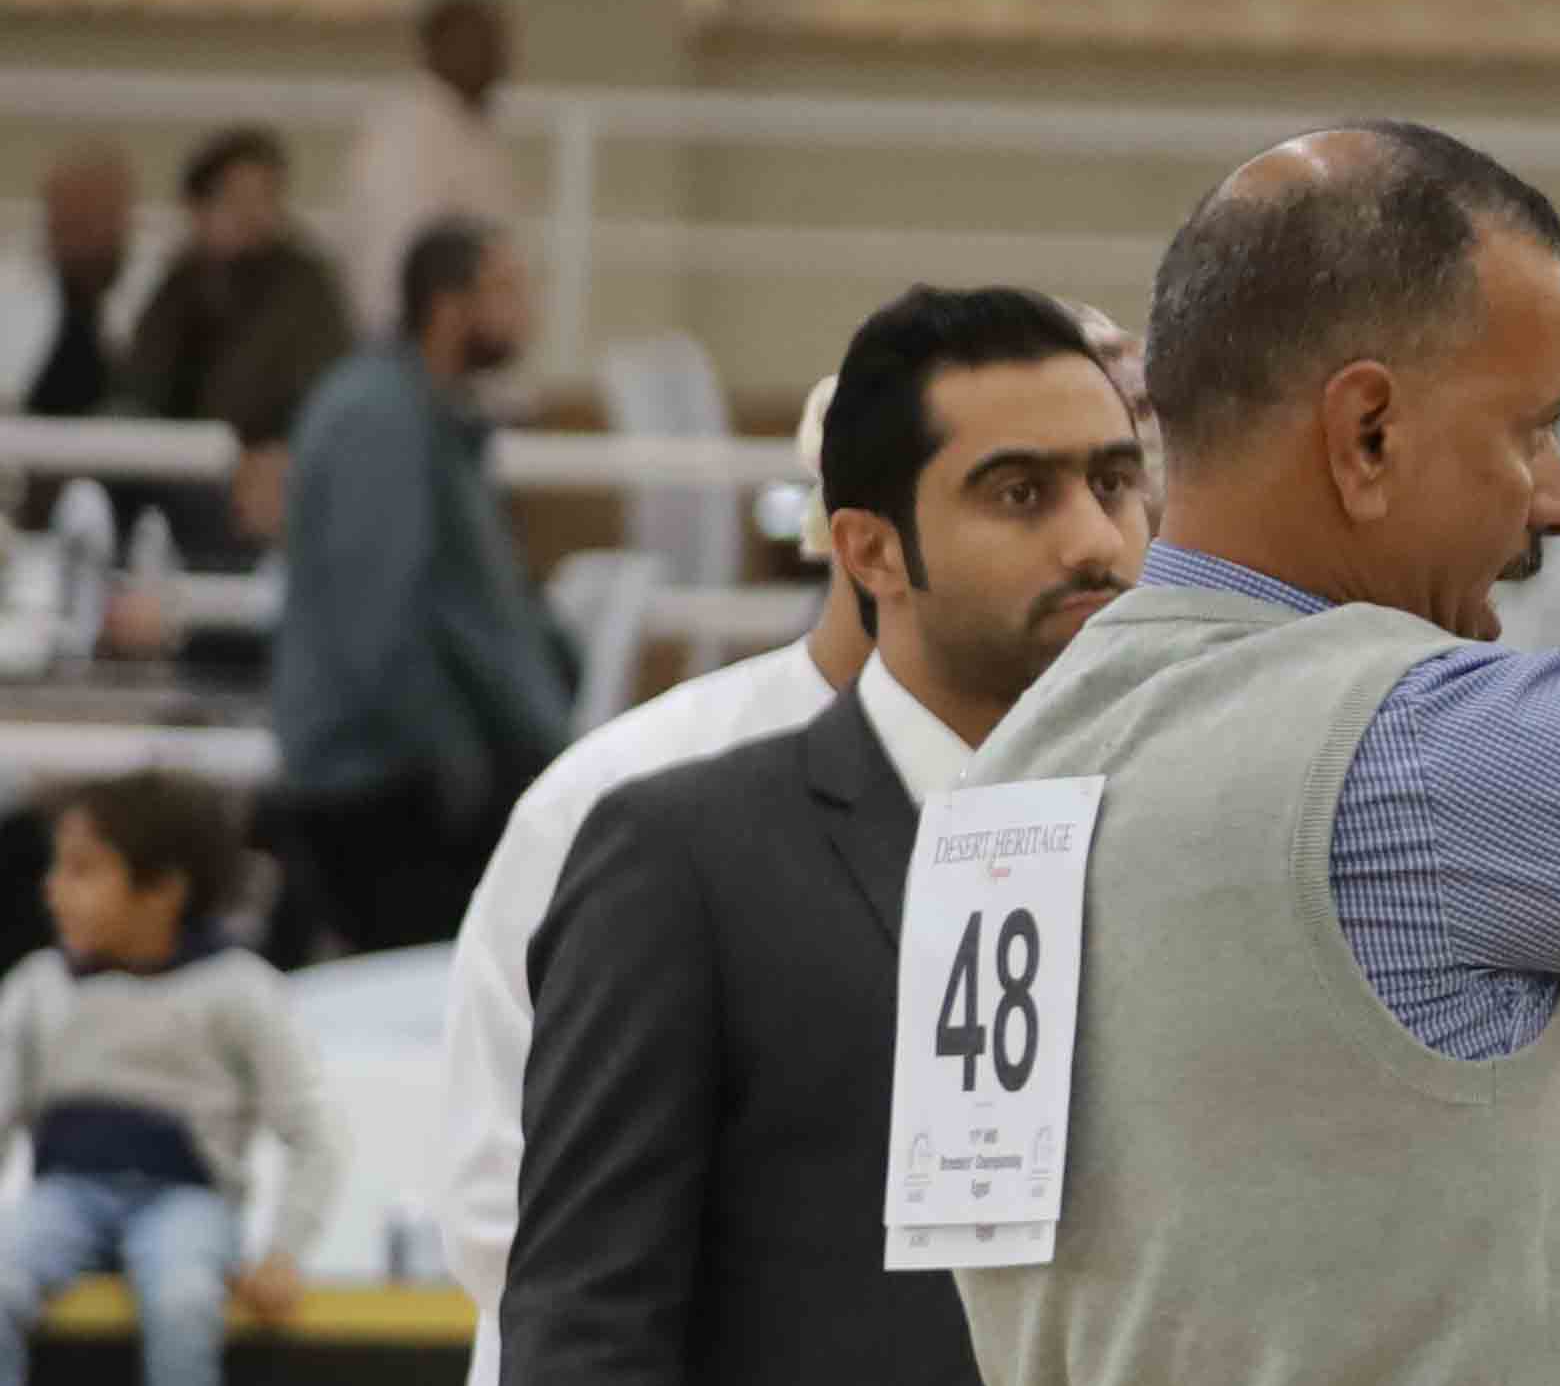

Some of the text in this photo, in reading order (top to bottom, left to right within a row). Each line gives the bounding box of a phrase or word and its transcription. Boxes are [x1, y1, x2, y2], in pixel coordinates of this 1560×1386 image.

[933, 823, 1075, 865] DESERT HERITAGE
[935, 908, 1040, 1093] 48
